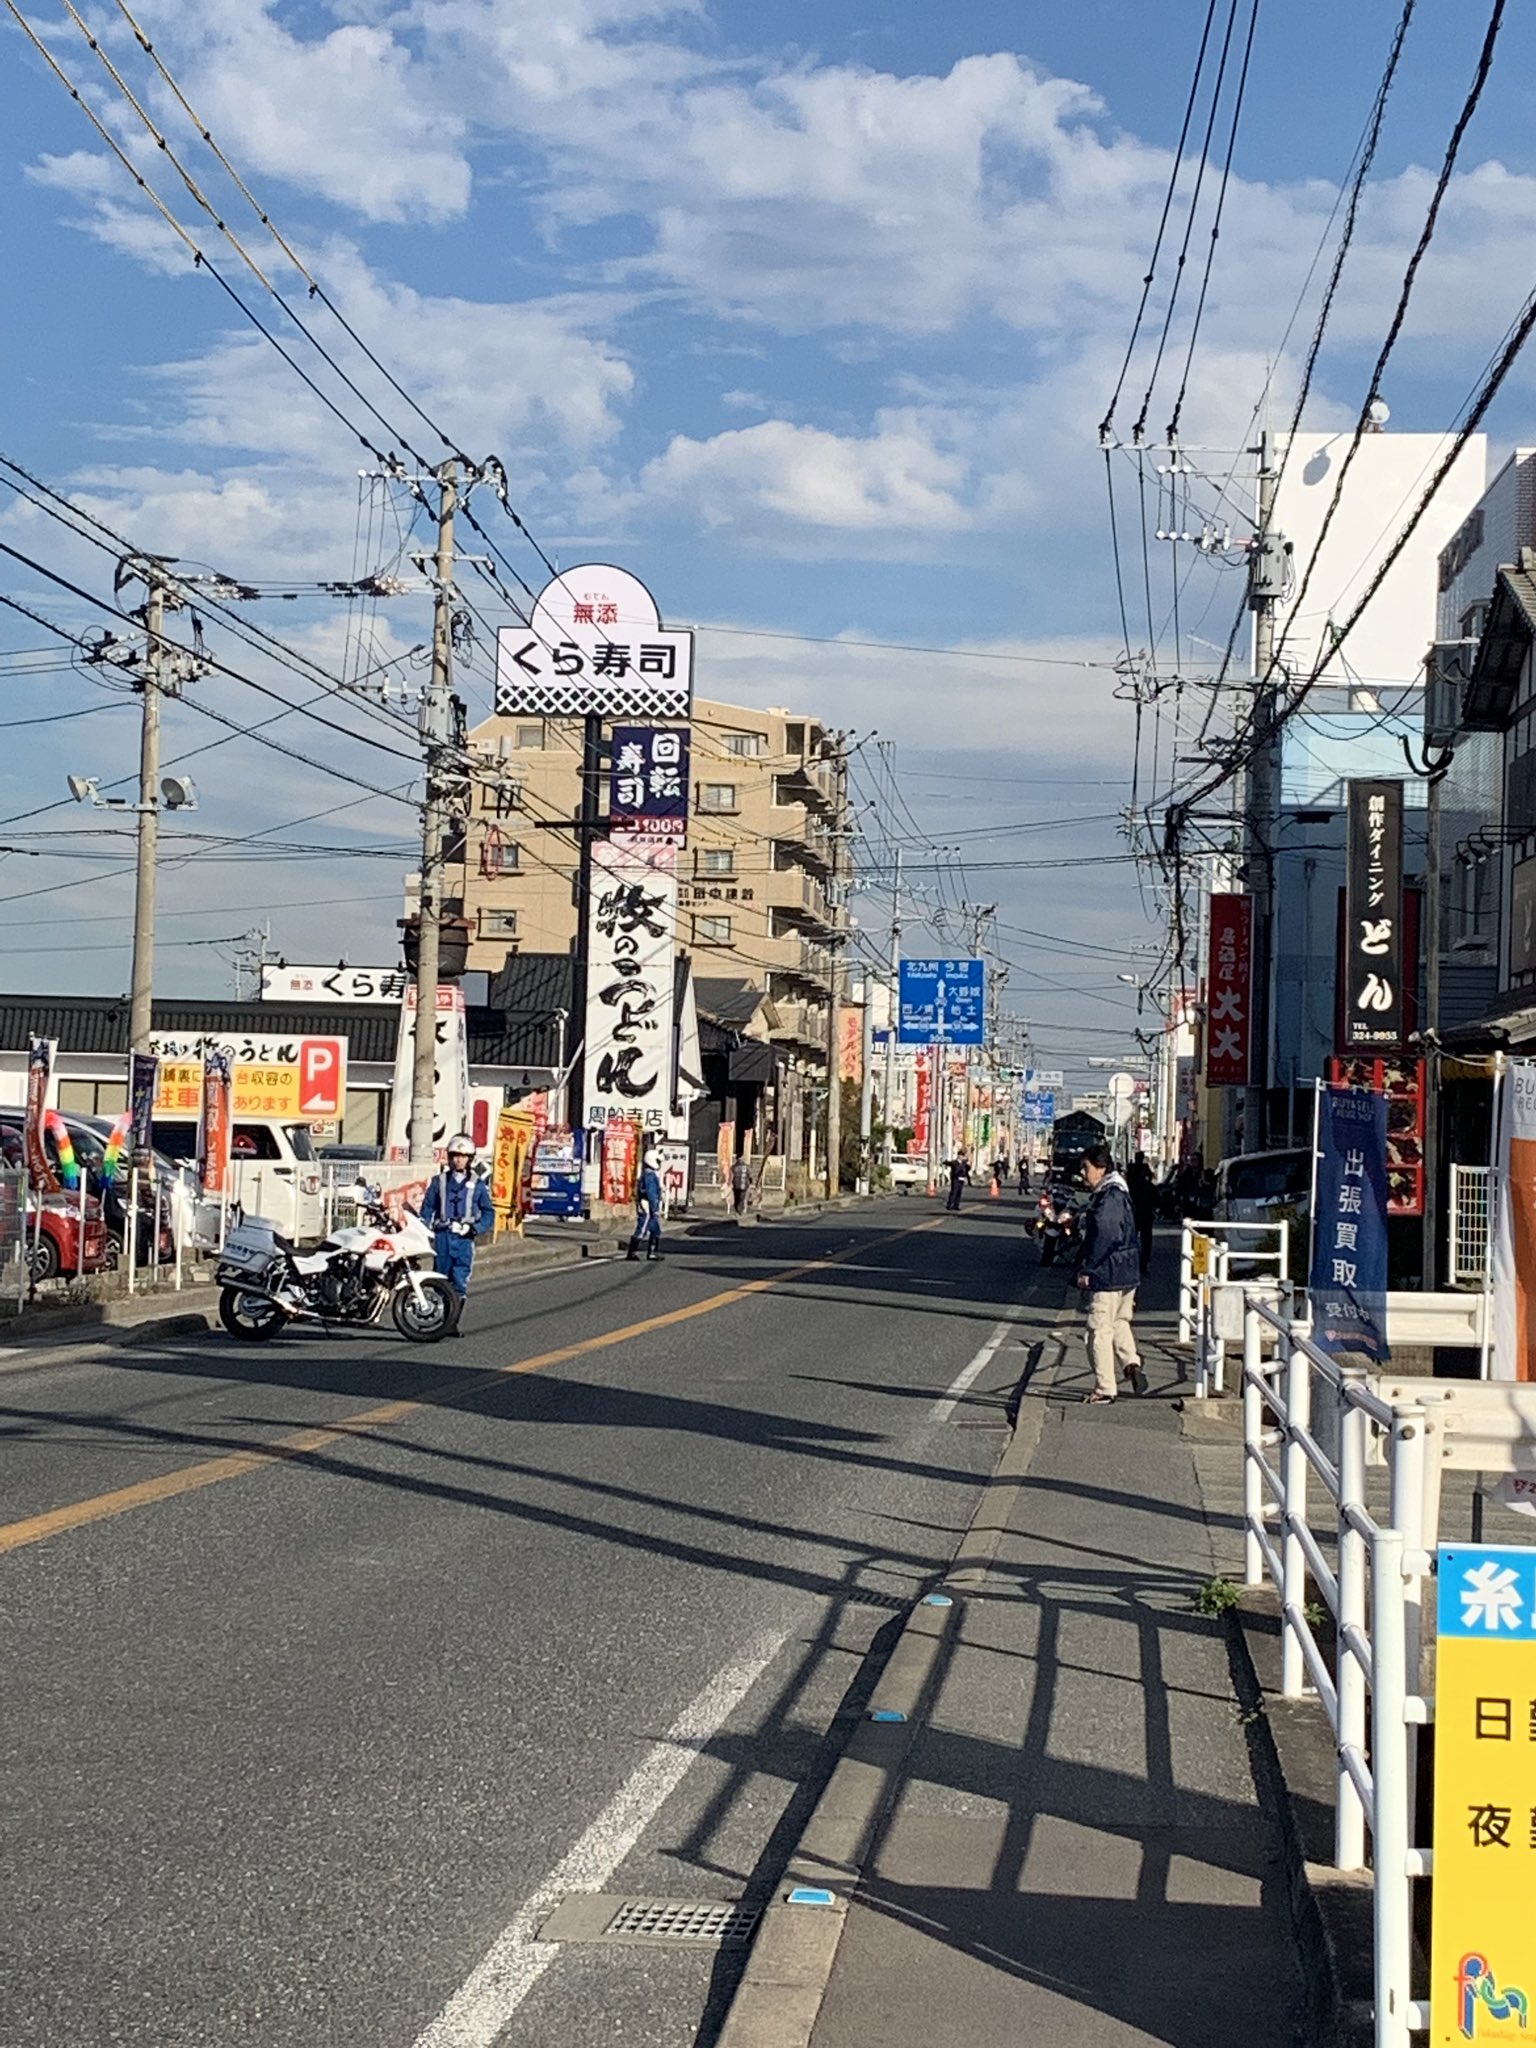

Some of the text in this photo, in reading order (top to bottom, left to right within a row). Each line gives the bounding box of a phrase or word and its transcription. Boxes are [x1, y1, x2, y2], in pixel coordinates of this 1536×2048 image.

[573, 603, 619, 624] 無添
[512, 640, 677, 679] くら寿司
[616, 741, 646, 808] 寿司
[650, 732, 683, 800] 回転
[1367, 794, 1386, 908] 創作ダイニング
[1357, 918, 1393, 1012] どん
[308, 1048, 333, 1082] P
[1331, 1148, 1365, 1289] 出張買取
[1325, 1302, 1370, 1322] 受付中
[1459, 1561, 1536, 1632] 糸
[1475, 1696, 1536, 1742] 日
[1467, 1804, 1536, 1849] 夜
